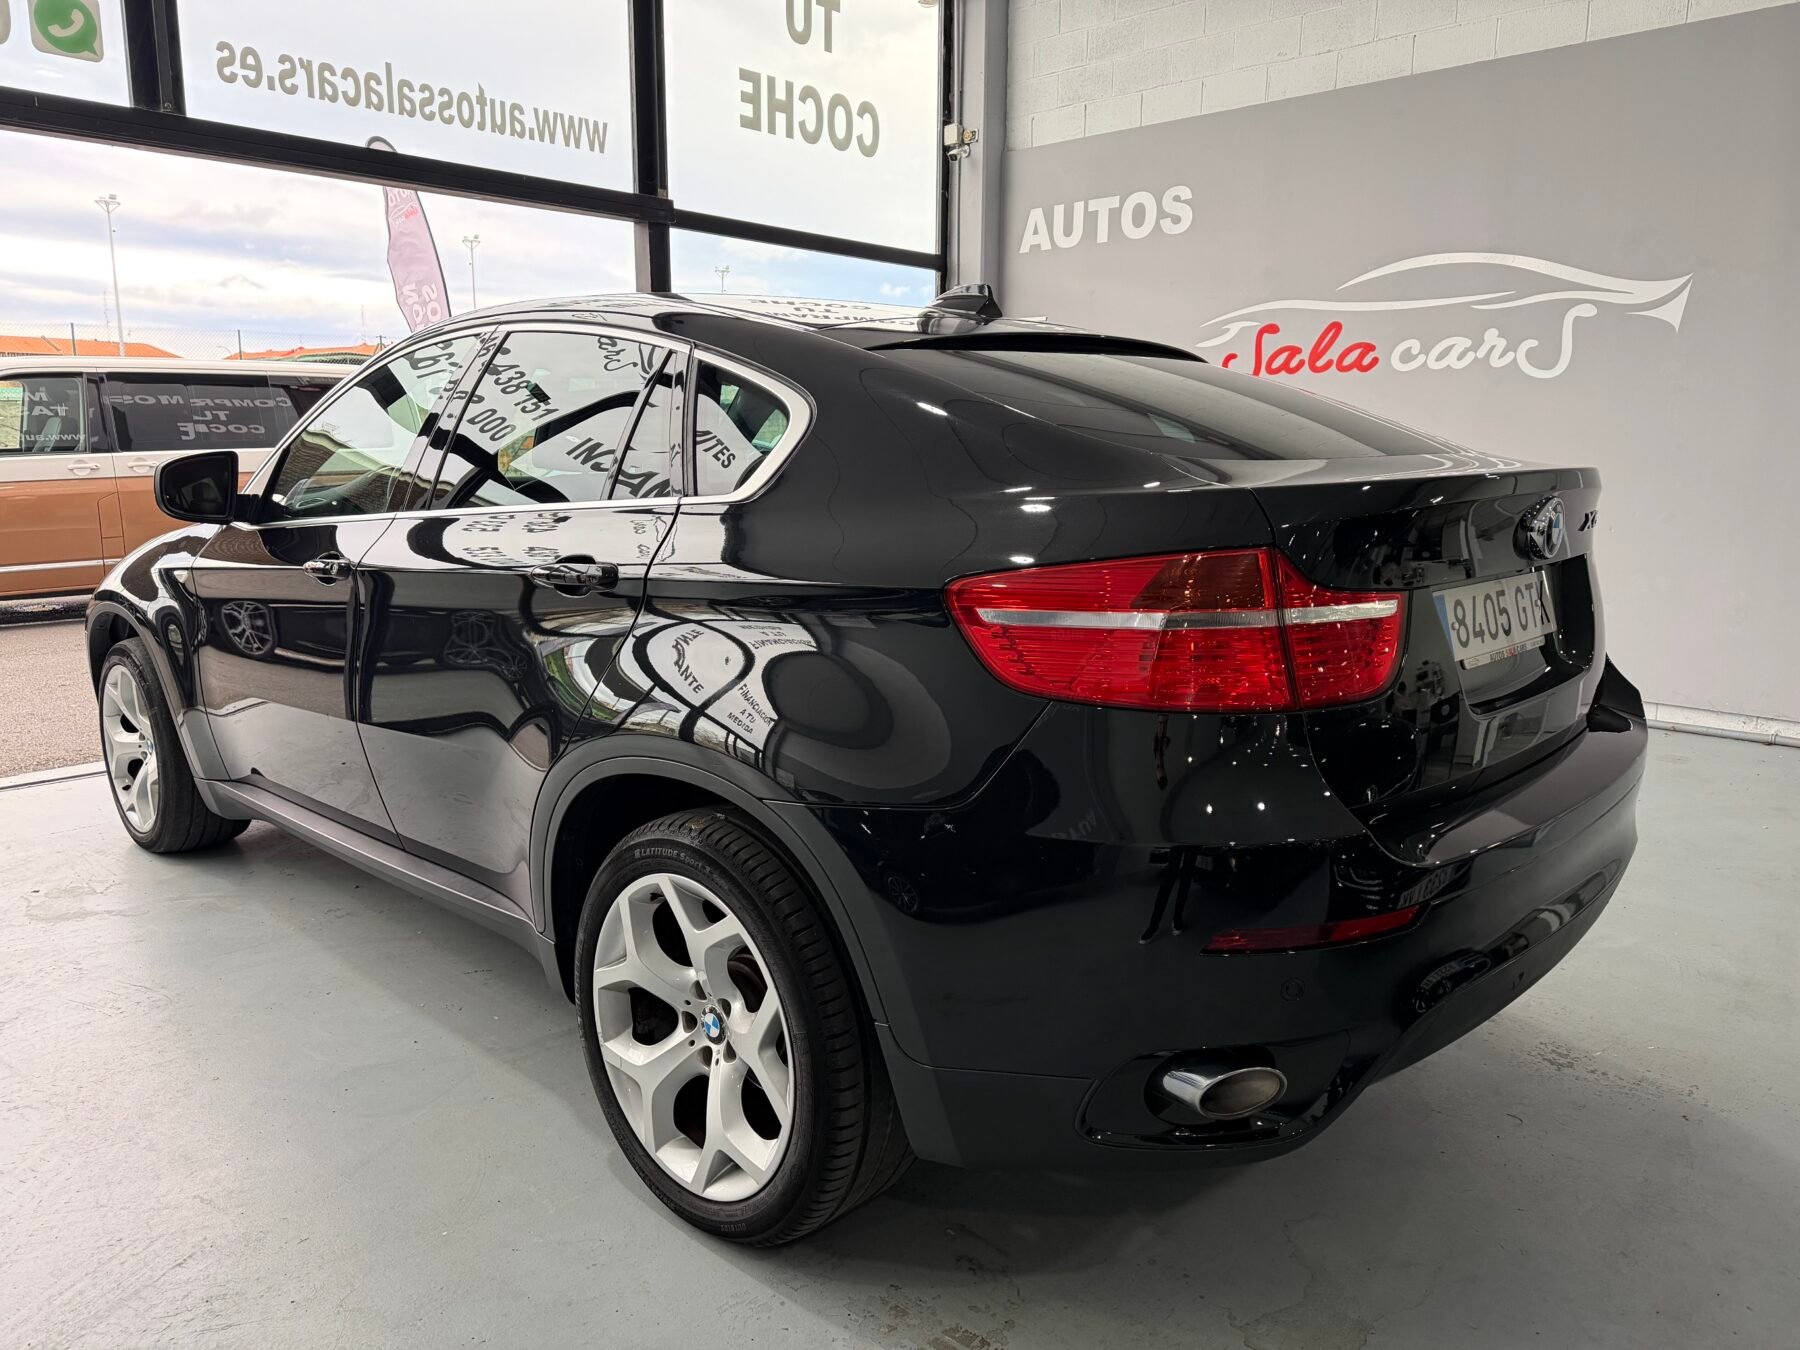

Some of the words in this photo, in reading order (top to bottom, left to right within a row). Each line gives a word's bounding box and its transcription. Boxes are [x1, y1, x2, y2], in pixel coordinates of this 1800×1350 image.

[1019, 184, 1193, 254] AUTOS
[1221, 320, 1380, 379] Sala
[1453, 590, 1512, 649] 8405
